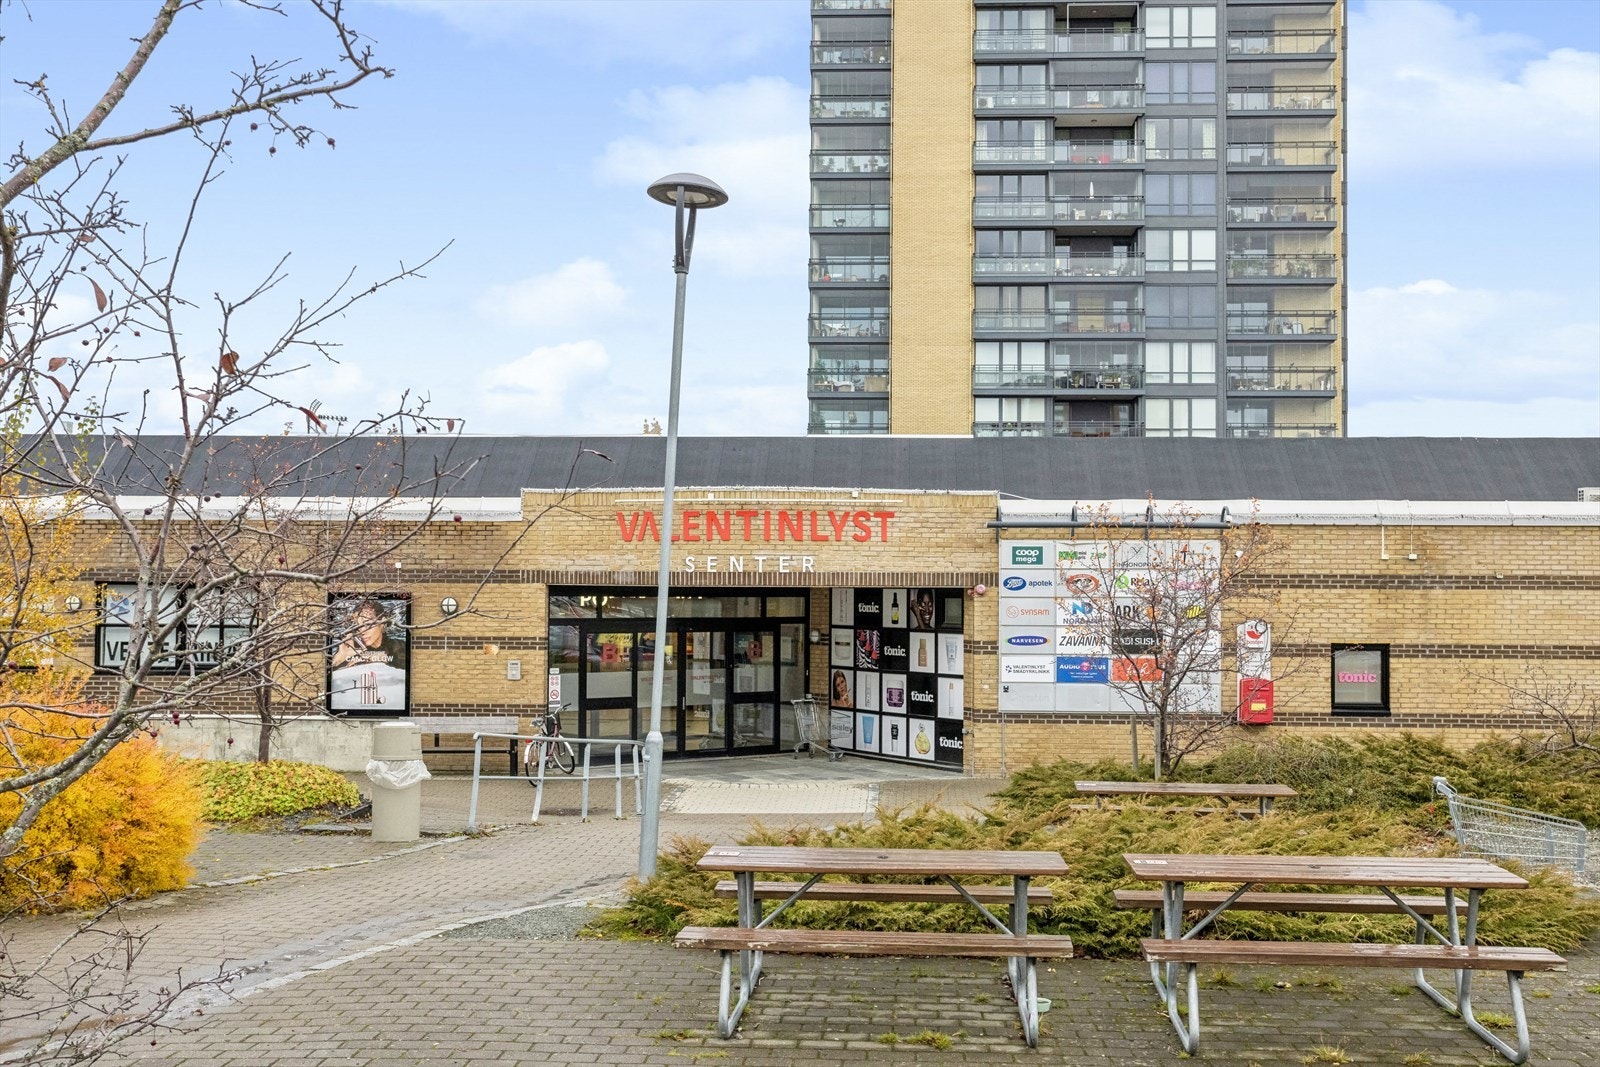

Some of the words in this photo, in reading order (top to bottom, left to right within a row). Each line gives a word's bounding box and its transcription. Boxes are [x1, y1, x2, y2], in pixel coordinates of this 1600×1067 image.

[617, 511, 895, 542] VAENTINLYST
[1015, 548, 1039, 557] coop
[685, 556, 814, 573] SENTER
[1028, 579, 1053, 587] apotek
[1059, 635, 1106, 647] ZAVANNA
[371, 655, 394, 663] GLOW
